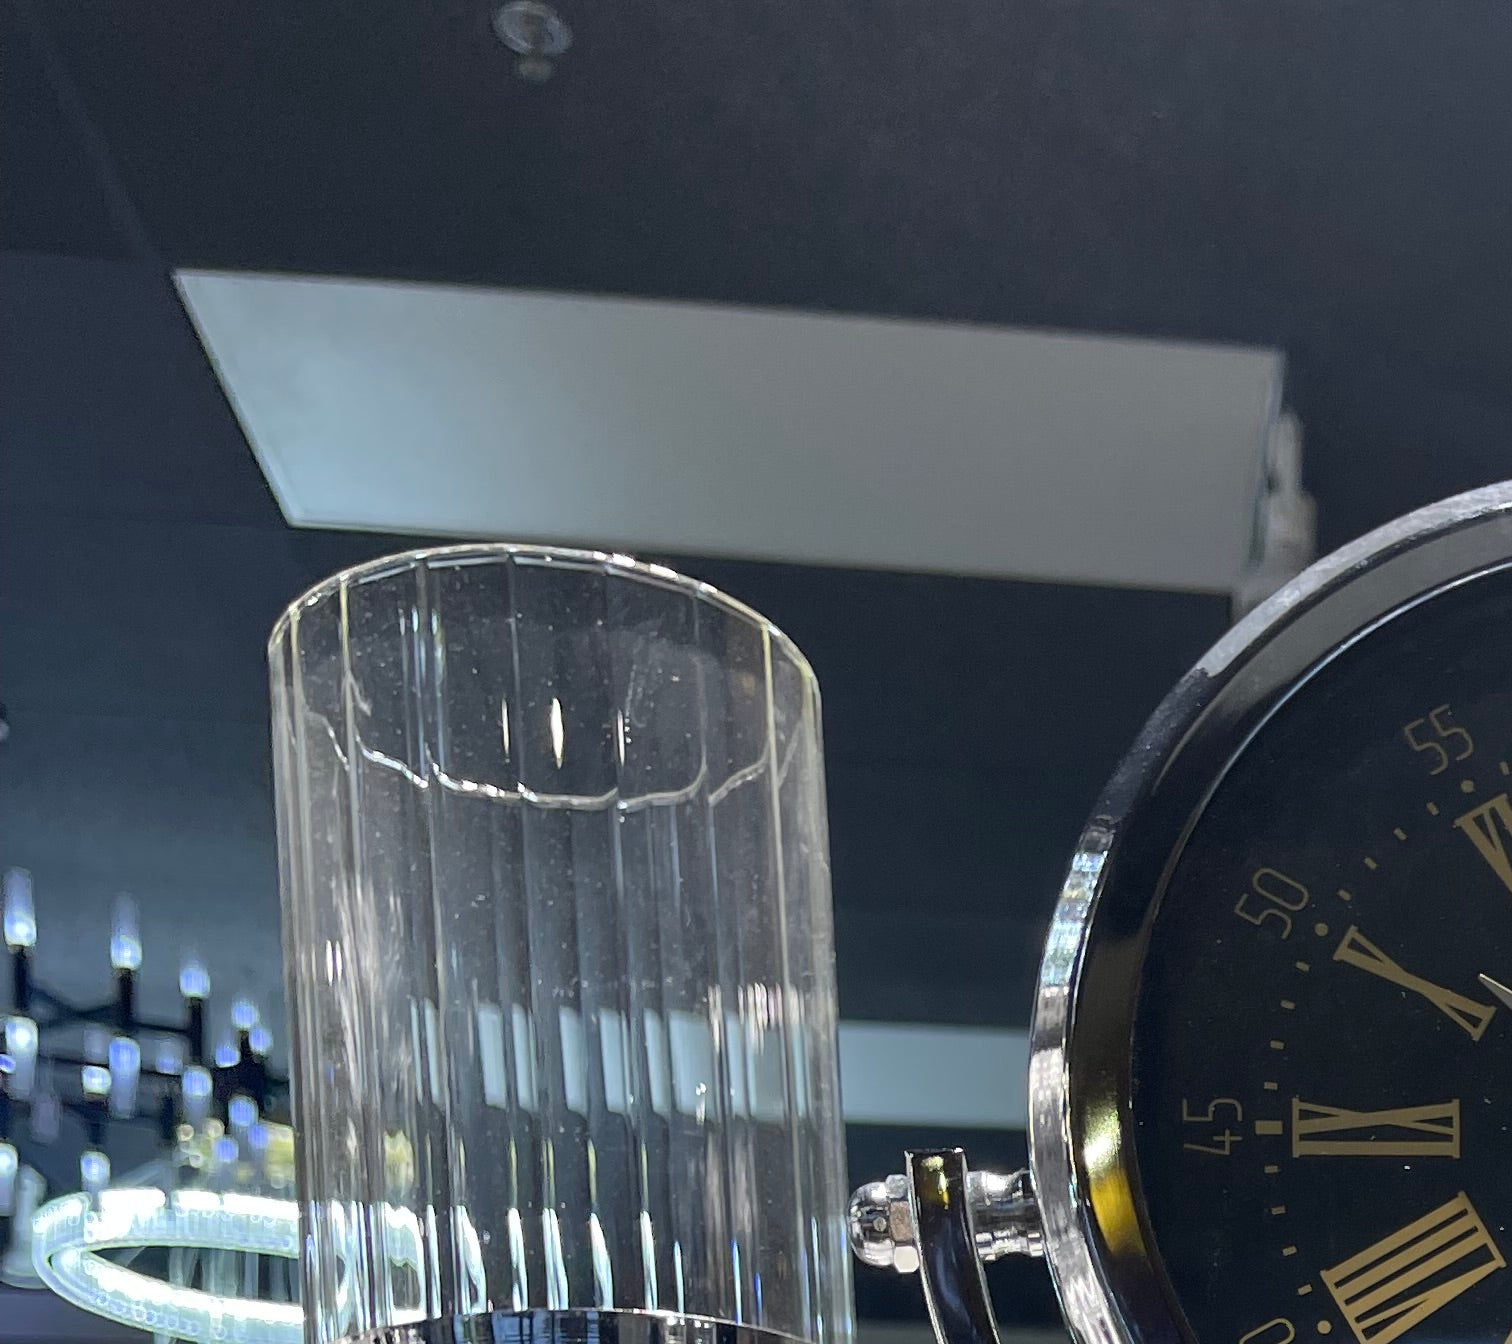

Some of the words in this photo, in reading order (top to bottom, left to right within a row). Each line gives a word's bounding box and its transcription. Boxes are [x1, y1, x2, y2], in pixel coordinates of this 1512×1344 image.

[1404, 706, 1473, 775] 55
[1234, 868, 1309, 939] 50
[1333, 926, 1496, 1041] X
[1183, 1098, 1242, 1156] 45
[1292, 1098, 1460, 1158] IX
